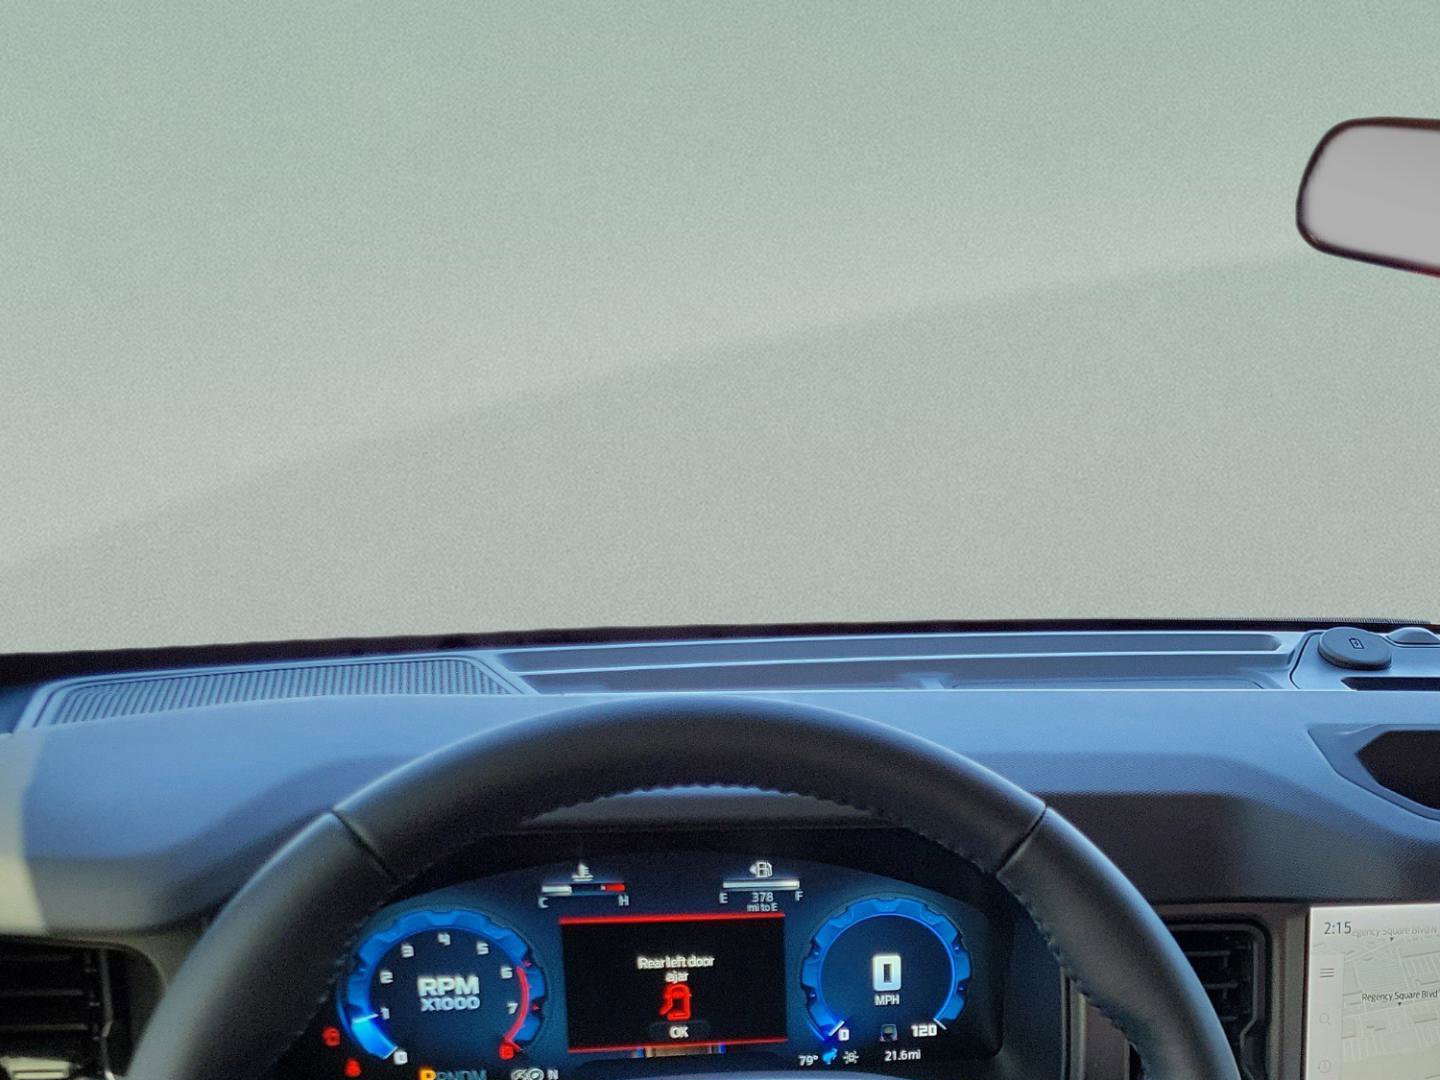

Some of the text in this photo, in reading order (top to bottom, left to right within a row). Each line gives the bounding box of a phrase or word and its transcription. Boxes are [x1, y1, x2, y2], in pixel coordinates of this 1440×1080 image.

[538, 897, 549, 908] C
[618, 895, 629, 906] H
[719, 892, 728, 904] E
[752, 891, 774, 903] 378
[795, 891, 803, 902] F
[747, 904, 759, 912] mi
[1324, 921, 1352, 935] 2:15
[1352, 929, 1381, 939] egency
[438, 933, 451, 946] 4
[401, 944, 414, 958] 3
[477, 942, 489, 955] 5
[637, 955, 714, 970] Rear left door
[379, 970, 394, 984] 2
[500, 966, 513, 979] 6
[665, 970, 689, 984] ajar
[873, 955, 901, 991] 0
[418, 976, 480, 997] RPM
[875, 994, 900, 1007] MPH
[1361, 990, 1438, 1003] Regency Square Blvd
[421, 997, 481, 1012] X1000
[507, 1002, 518, 1014] 7
[381, 1007, 390, 1020] 1
[669, 1026, 689, 1039] OK
[838, 1028, 850, 1041] 0
[911, 1023, 937, 1038] 120
[547, 1069, 558, 1080] N
